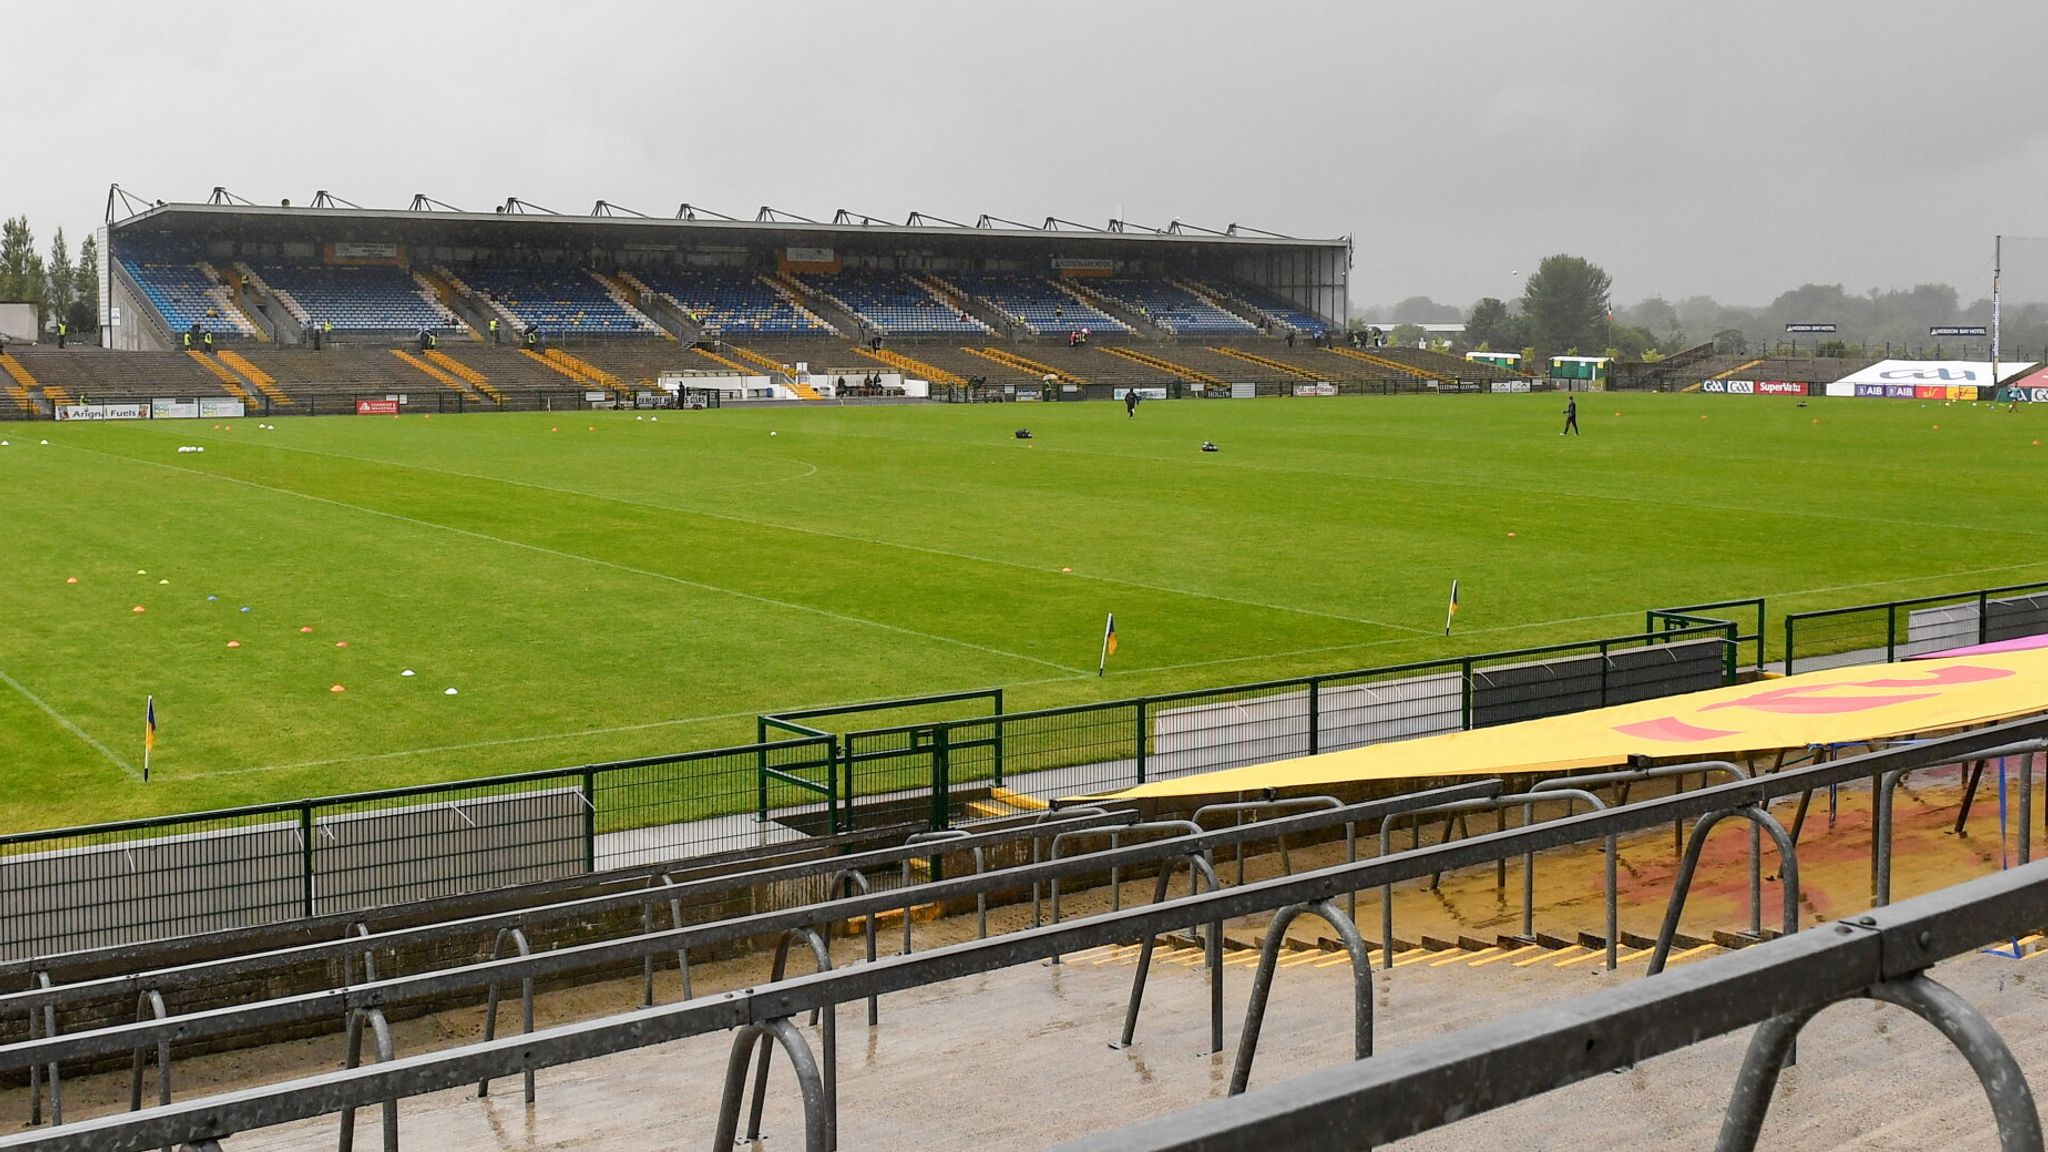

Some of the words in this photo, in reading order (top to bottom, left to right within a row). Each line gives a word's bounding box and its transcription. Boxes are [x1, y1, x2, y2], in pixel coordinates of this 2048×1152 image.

[1703, 380, 1725, 392] GAA
[1730, 381, 1750, 392] GAA
[1759, 381, 1801, 393] SuperValu
[1866, 387, 1882, 396] AIB
[1896, 388, 1913, 396] AIB
[110, 406, 136, 417] Fuels
